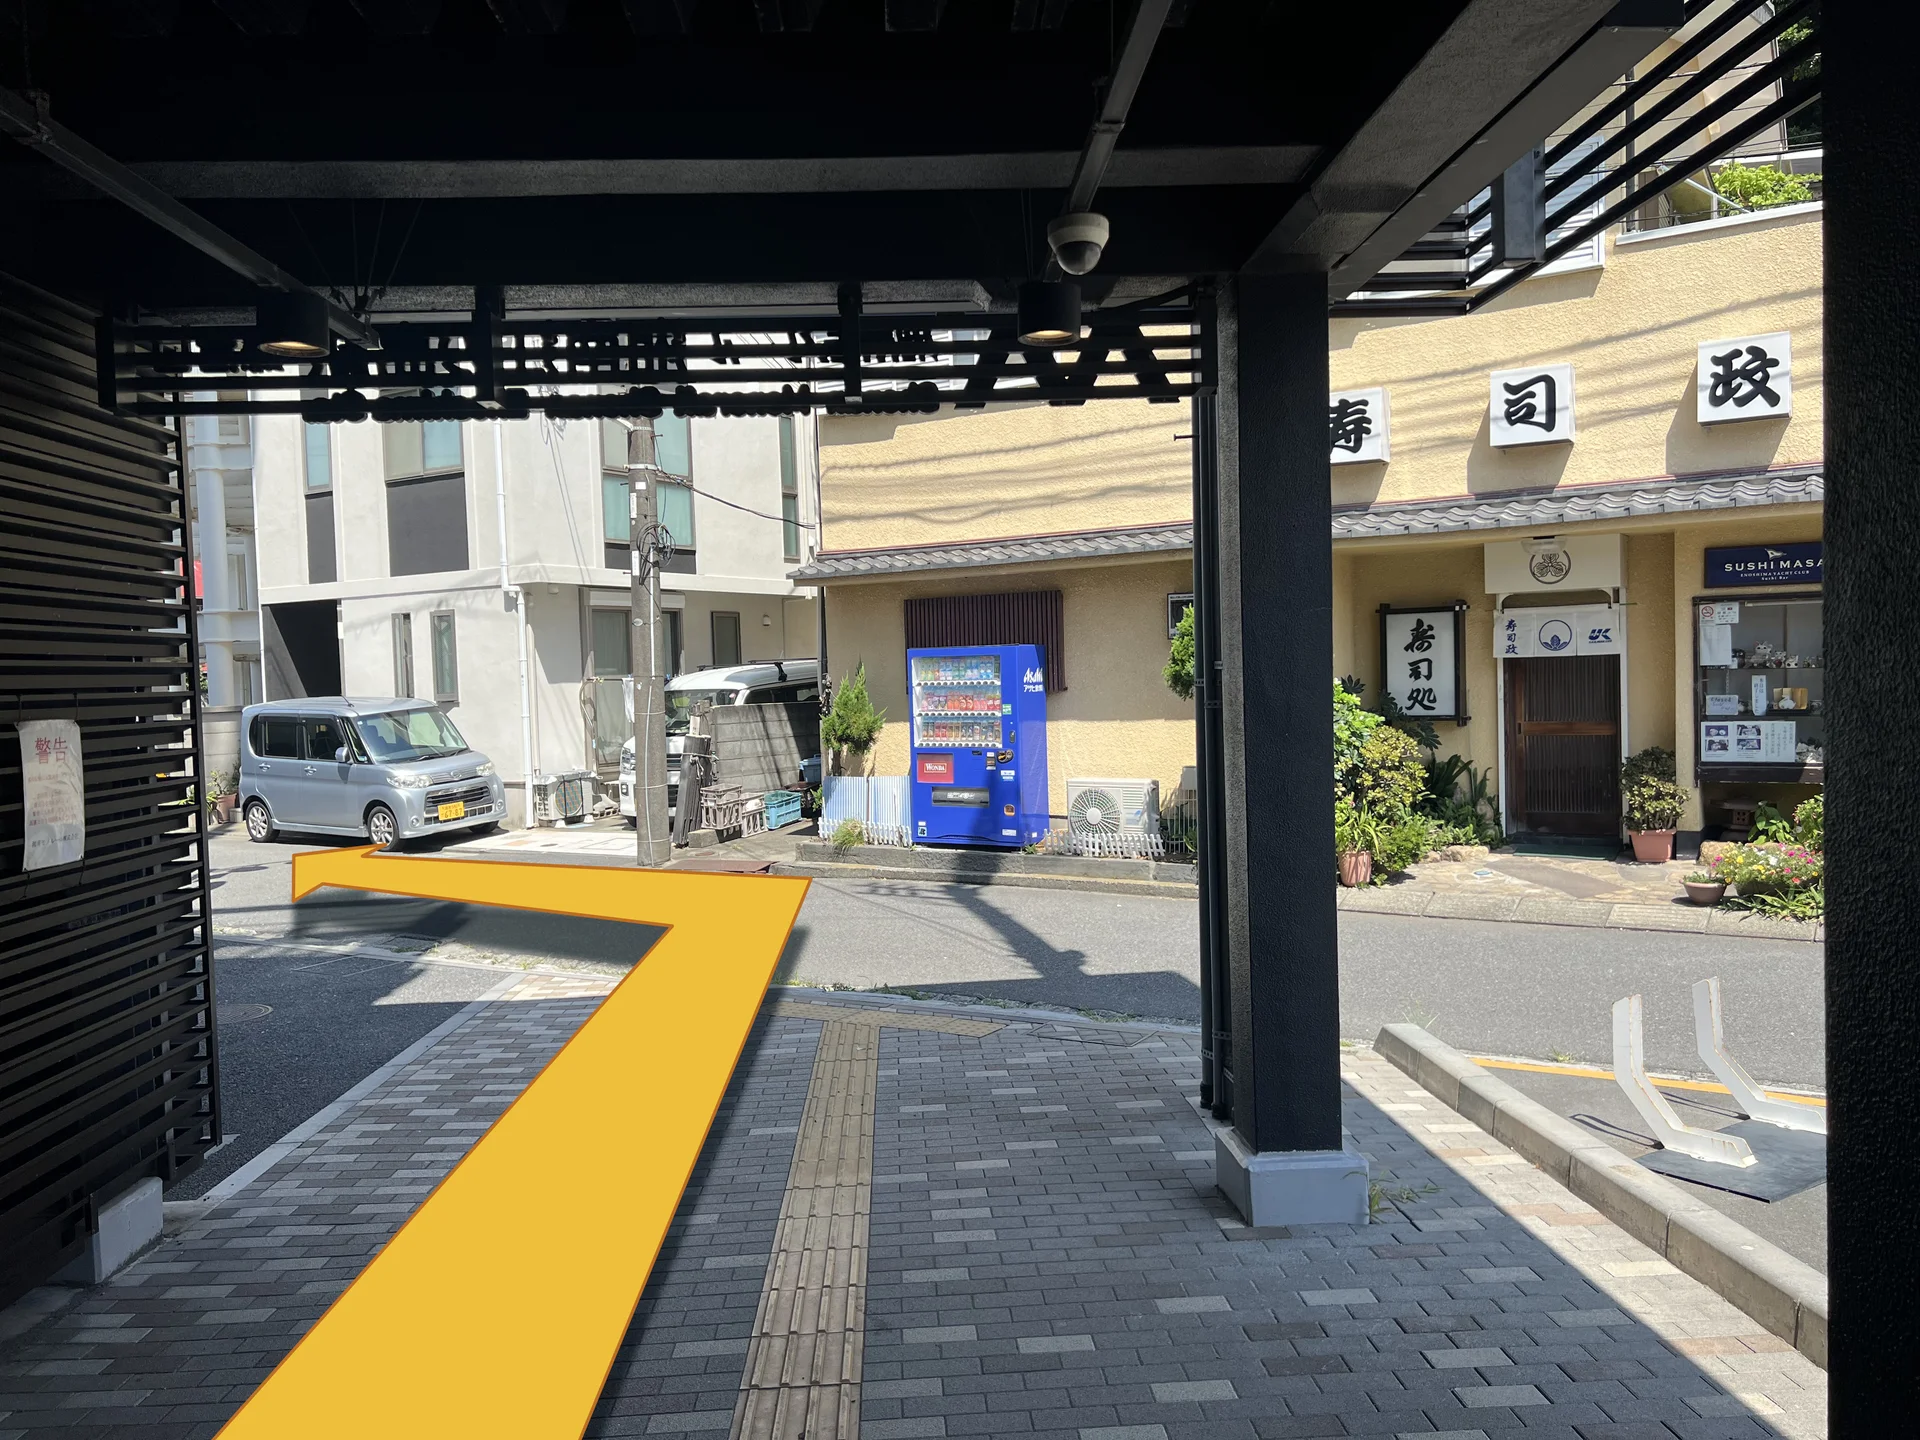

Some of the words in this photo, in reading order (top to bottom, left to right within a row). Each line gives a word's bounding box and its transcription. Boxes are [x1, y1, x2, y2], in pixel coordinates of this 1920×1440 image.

[1329, 398, 1372, 453] 寿
[1502, 373, 1557, 432] 司
[1708, 344, 1782, 408] 政
[1724, 561, 1774, 571] SUSHI
[1504, 618, 1519, 656] 寿司政
[1588, 627, 1612, 641] UK
[1023, 667, 1043, 684] Asahi
[1403, 617, 1437, 711] 寿司処
[35, 737, 68, 764] 警告
